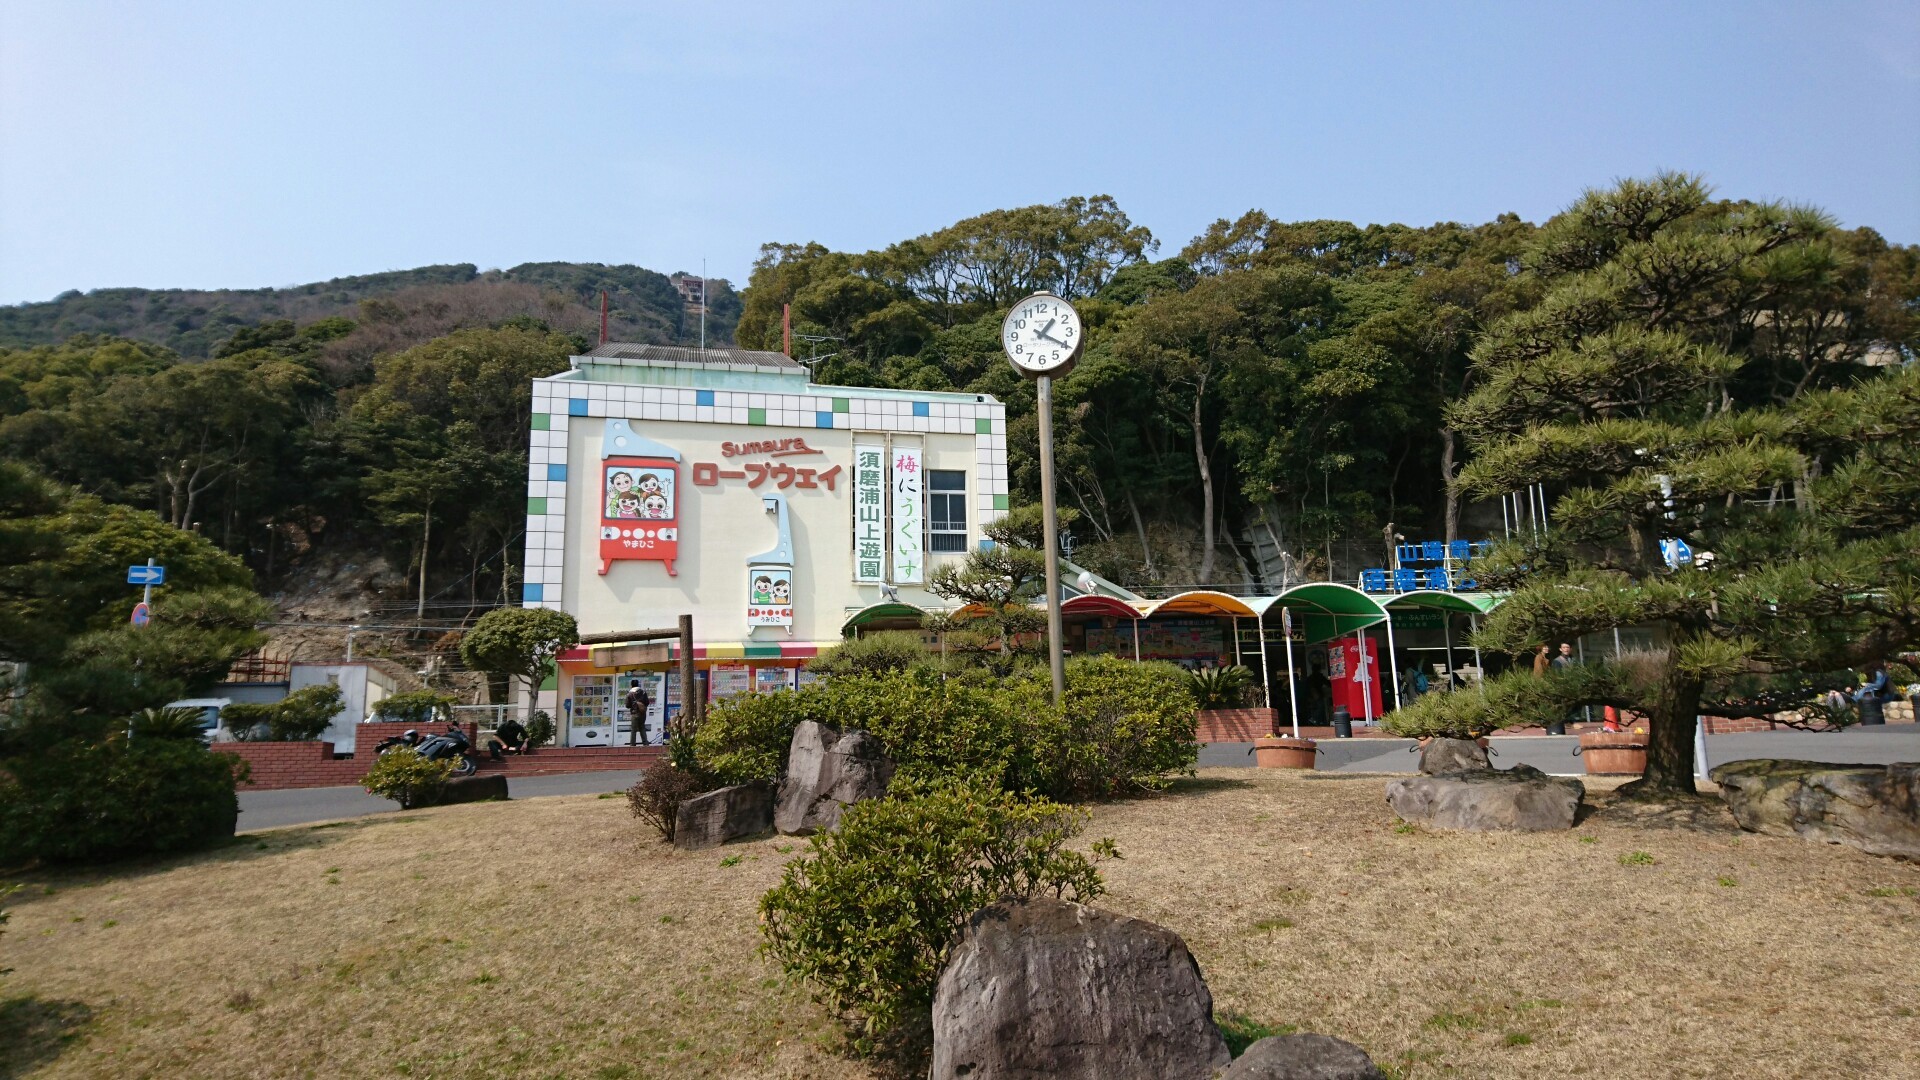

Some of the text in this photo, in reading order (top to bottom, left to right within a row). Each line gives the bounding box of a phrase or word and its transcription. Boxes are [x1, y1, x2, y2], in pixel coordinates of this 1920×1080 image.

[1022, 308, 1033, 319] 11
[1034, 303, 1048, 314] 12
[1053, 306, 1058, 317] 1
[1013, 319, 1026, 330] 10
[1061, 314, 1069, 325] 2
[1010, 331, 1019, 342] 9
[1065, 327, 1073, 337] 3
[1015, 344, 1023, 354] 8
[1026, 352, 1035, 363] 7
[1038, 355, 1046, 365] 6
[1052, 350, 1060, 360] 5
[721, 437, 824, 458] Sumaura
[692, 462, 842, 491] ロープウェイ
[859, 451, 881, 578] 須磨浦山上遊園
[895, 454, 920, 579] 梅にうぐいす
[623, 540, 655, 549] やまひこ
